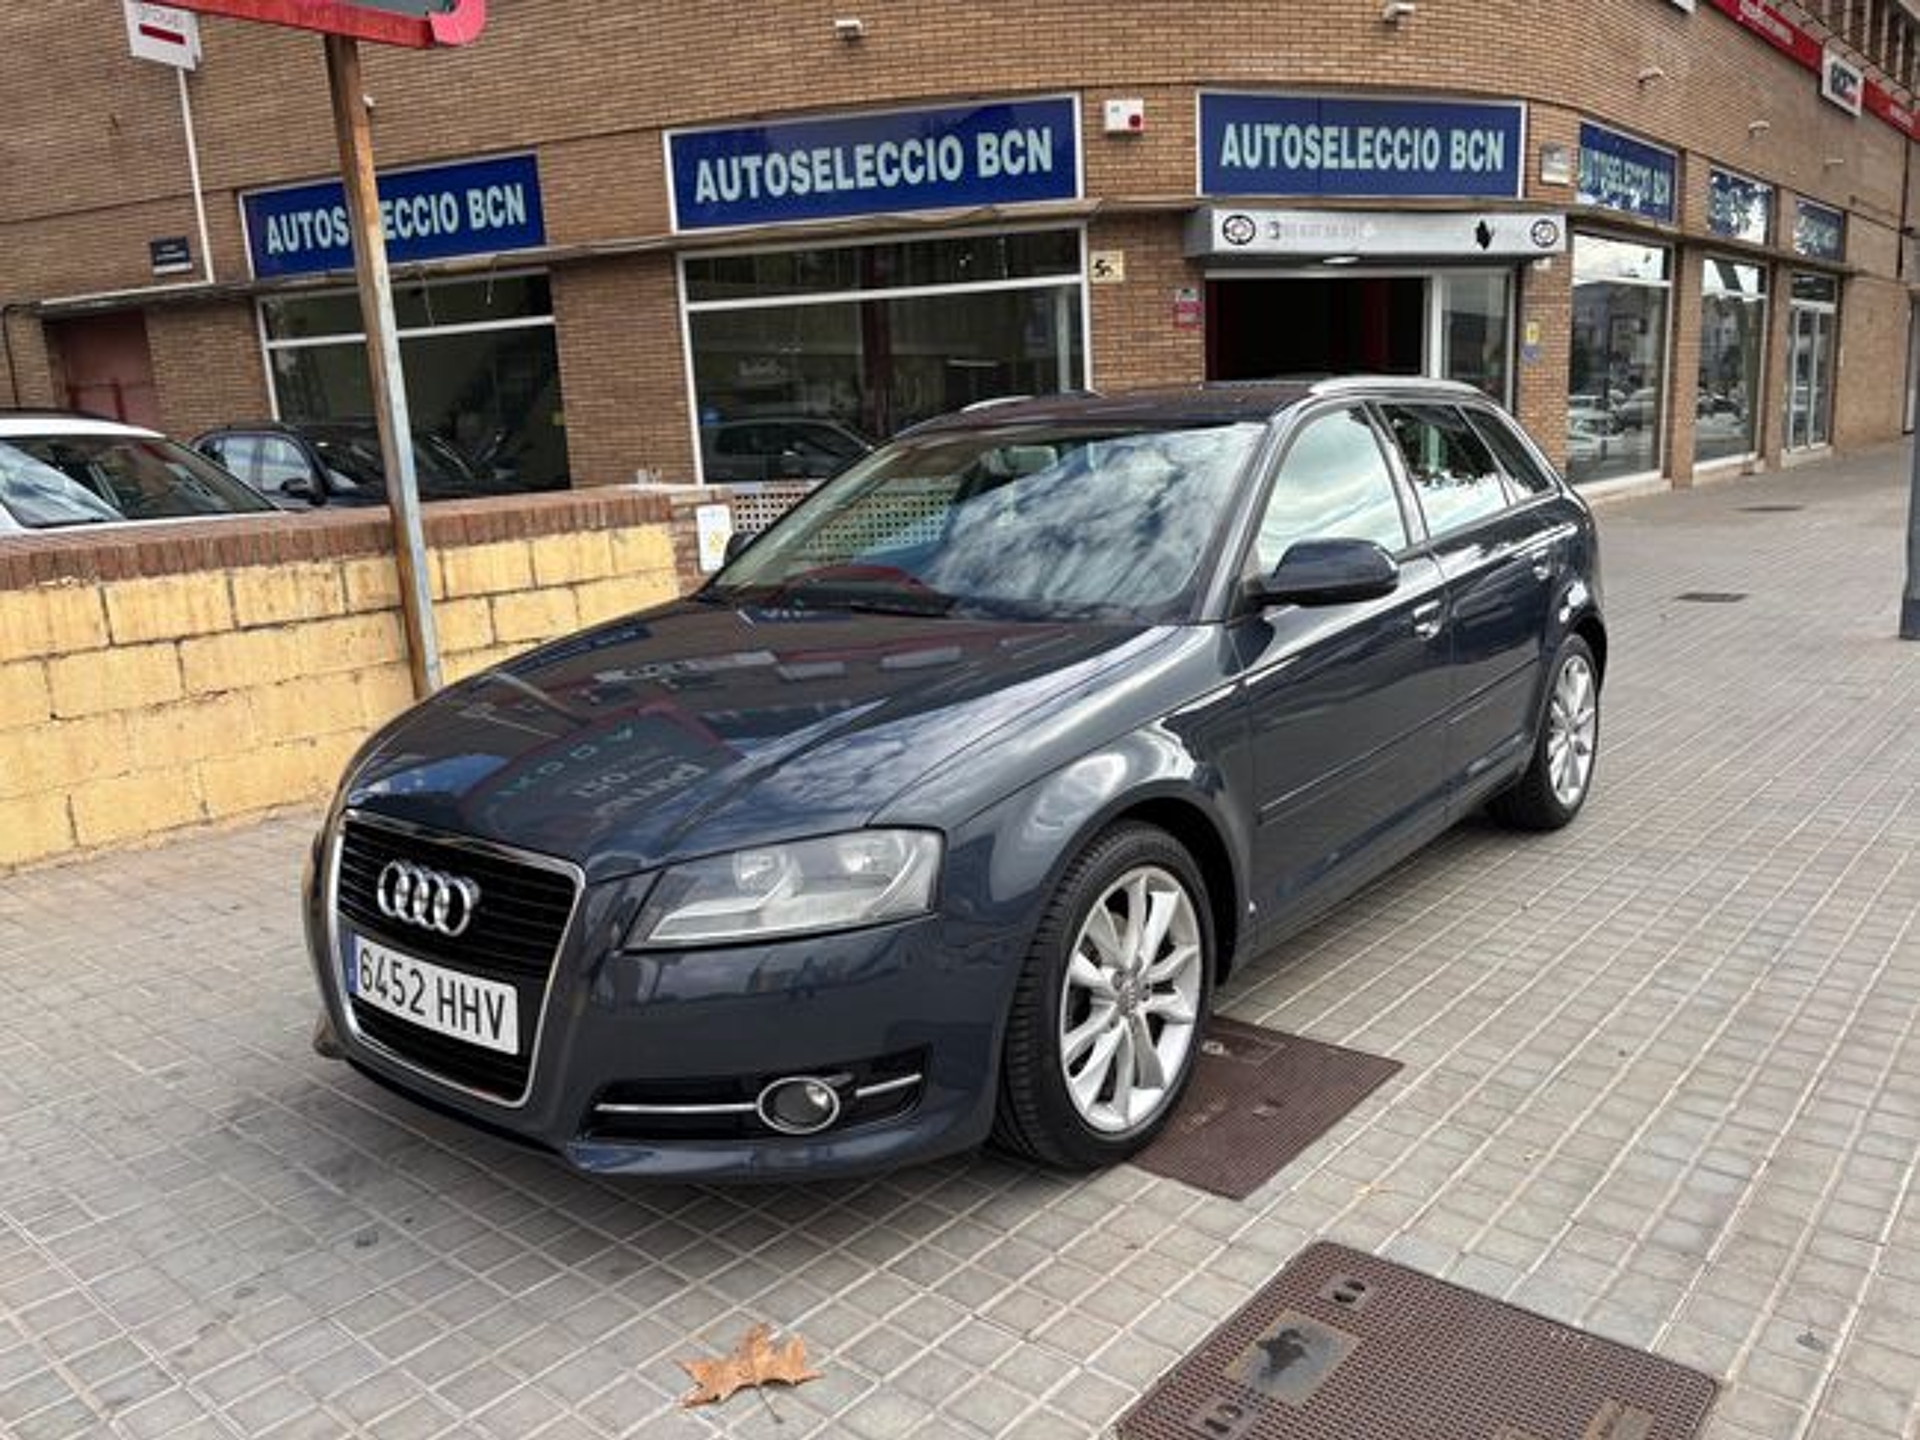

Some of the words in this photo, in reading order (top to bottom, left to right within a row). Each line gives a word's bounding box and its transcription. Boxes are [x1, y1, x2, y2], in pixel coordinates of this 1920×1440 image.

[695, 134, 964, 203] AUTOSELECCIO
[976, 127, 1053, 178] BCN
[1220, 123, 1440, 172] AUTOSELECCIO
[1450, 129, 1504, 172] BCN
[267, 191, 459, 254] AUTOSECCIO
[466, 183, 527, 231] BCN
[360, 948, 426, 1016] 6452
[437, 976, 506, 1040] HHV
